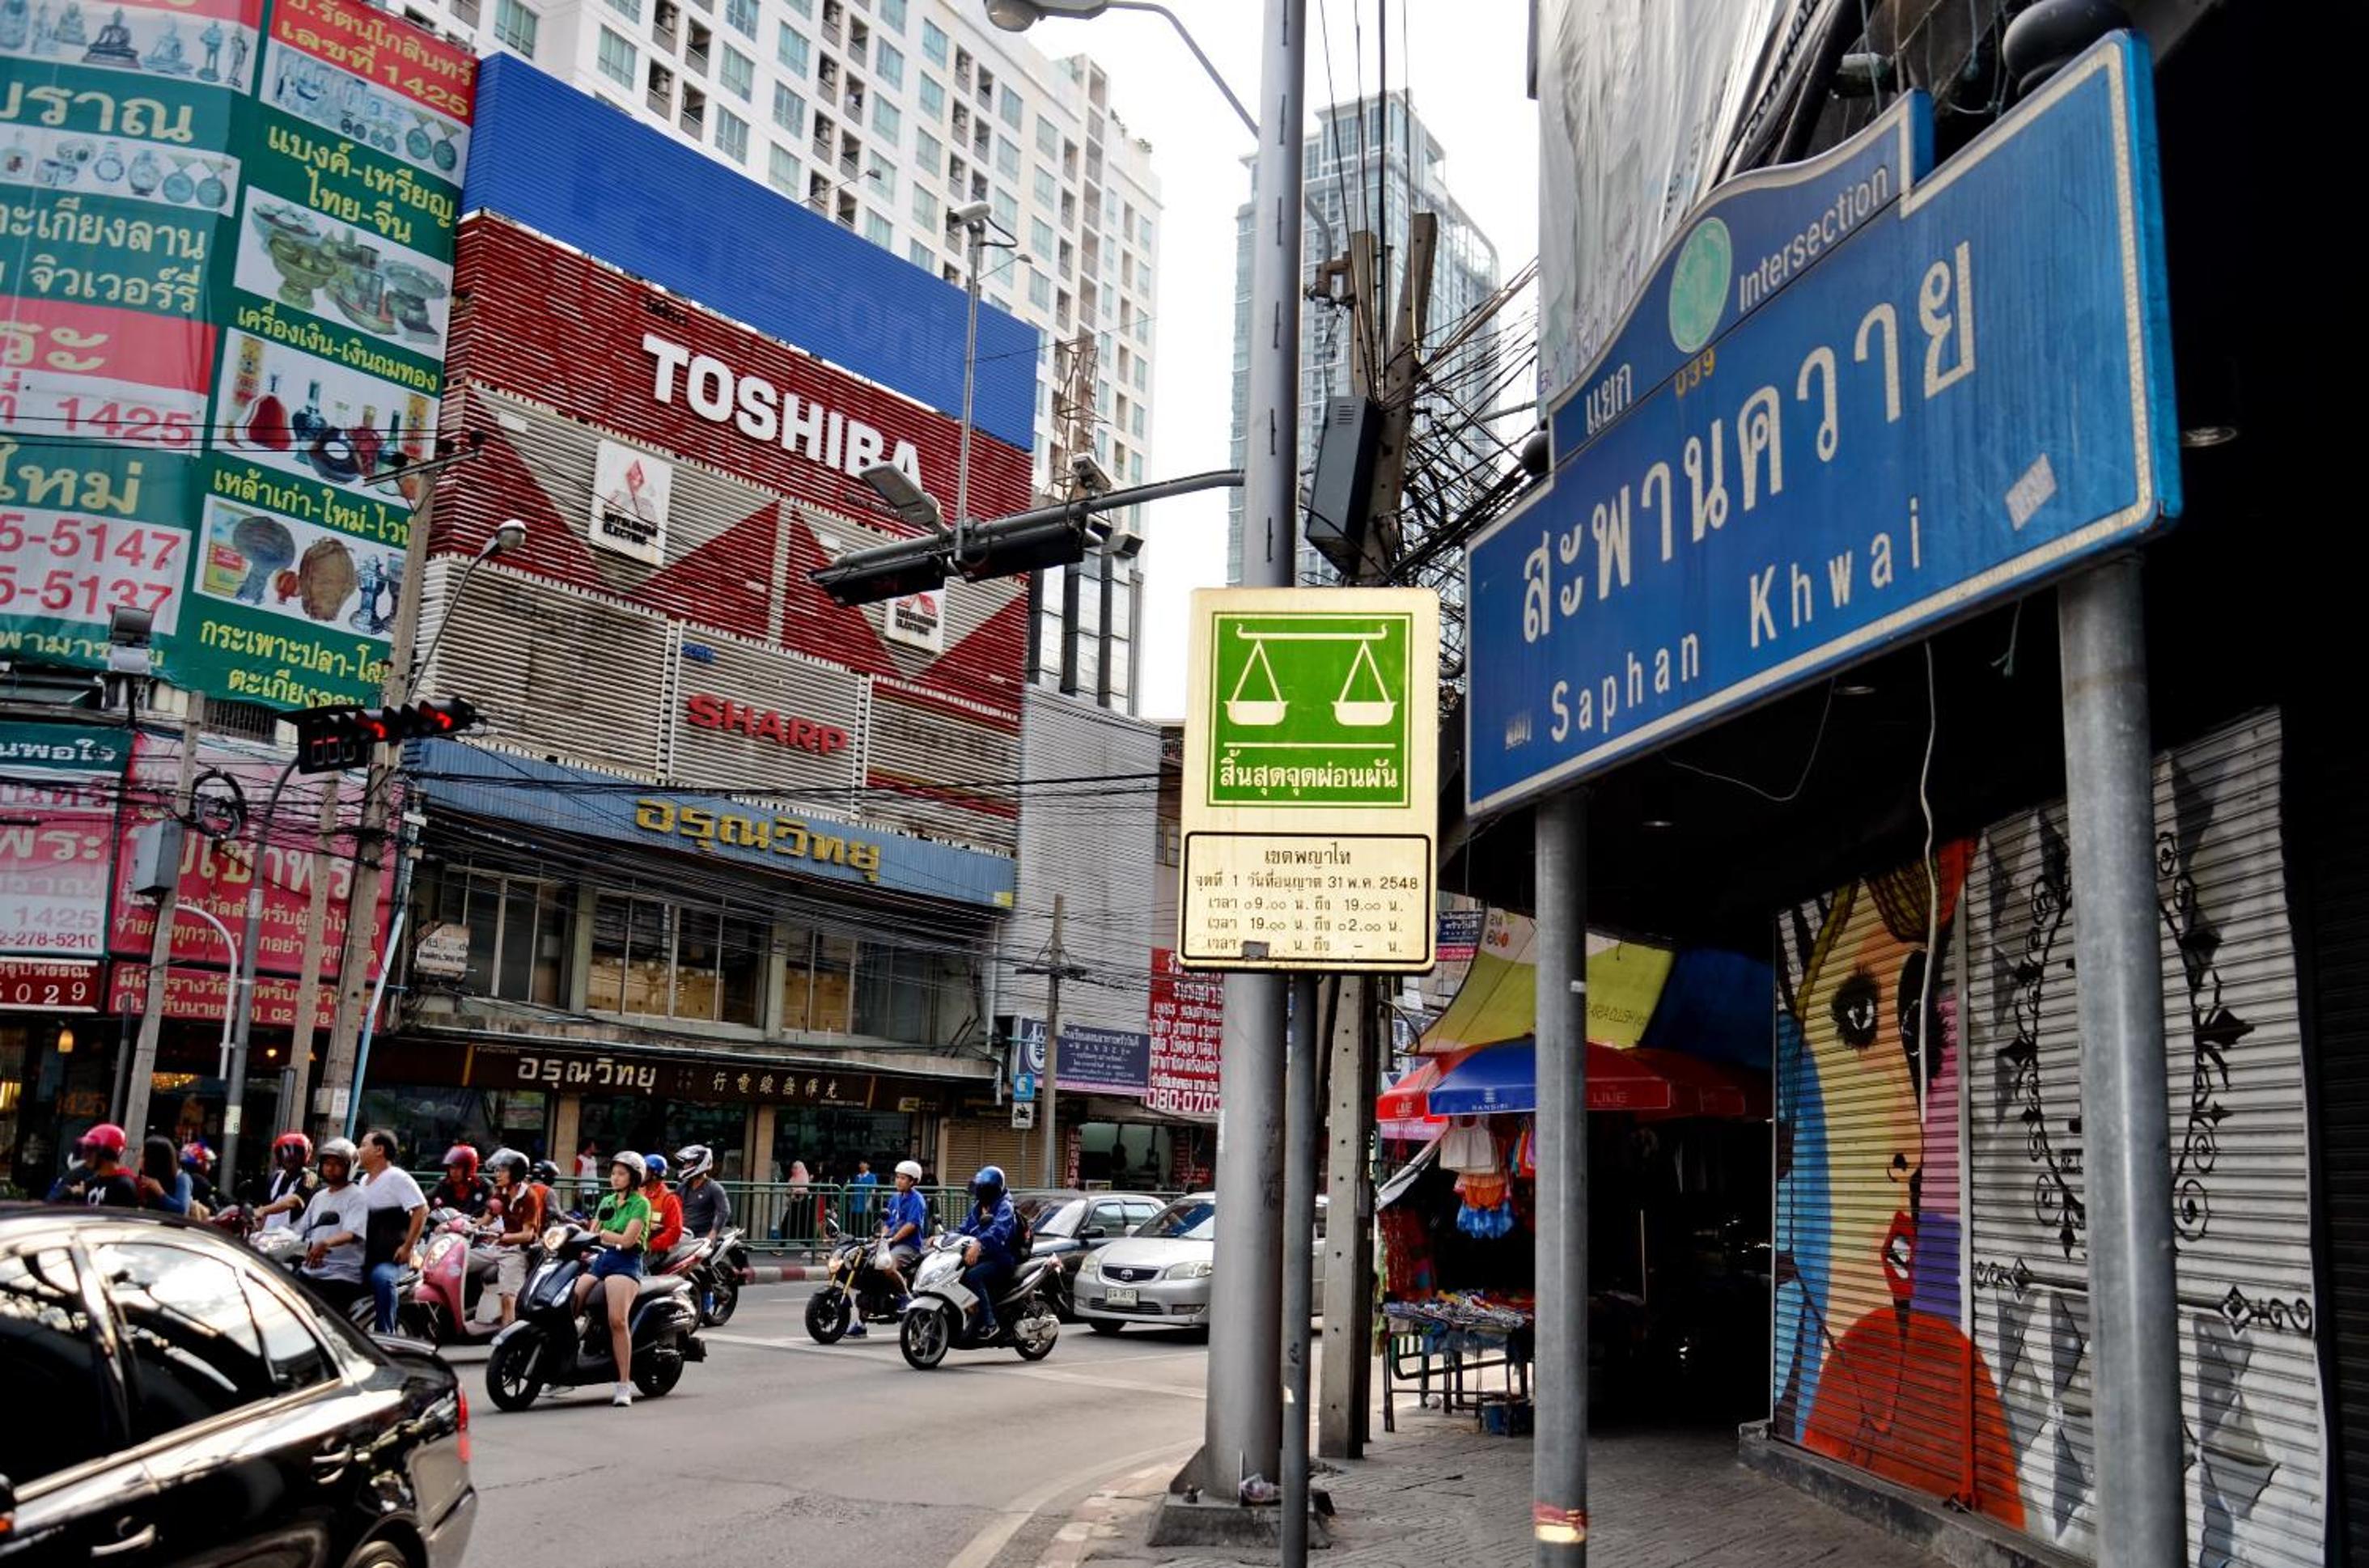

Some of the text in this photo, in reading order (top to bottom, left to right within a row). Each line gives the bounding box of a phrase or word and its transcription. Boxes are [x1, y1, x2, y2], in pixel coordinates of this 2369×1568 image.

[281, 20, 468, 117] เลขที่ 1425
[304, 164, 412, 243] ไทย-จีน
[1738, 162, 1889, 314] Intersection
[57, 397, 194, 447] 1425
[642, 333, 924, 490] TOSHIBA
[1586, 362, 1632, 435] แยก
[1523, 241, 1977, 645] สะพานควาย
[1551, 497, 1922, 744] Saphan Khwai
[686, 693, 849, 756] SHARP
[1220, 748, 1398, 796] สิ้นสุดจุดผ่อนผัน
[635, 798, 880, 883] อรุณวิทยุ
[1265, 841, 1350, 869] เขตพญาไท
[1209, 897, 1238, 909] เวลา
[1295, 899, 1309, 910] น.
[1315, 895, 1331, 910] ถึง
[1389, 901, 1403, 912] น.
[1233, 875, 1238, 887] 1
[1328, 876, 1342, 889] 31
[1379, 876, 1418, 889] 2548
[1208, 918, 1237, 930] เวลา
[1315, 915, 1331, 931] ถึง
[1388, 921, 1403, 932] น.
[517, 1057, 657, 1095] อรุณวิทยุ
